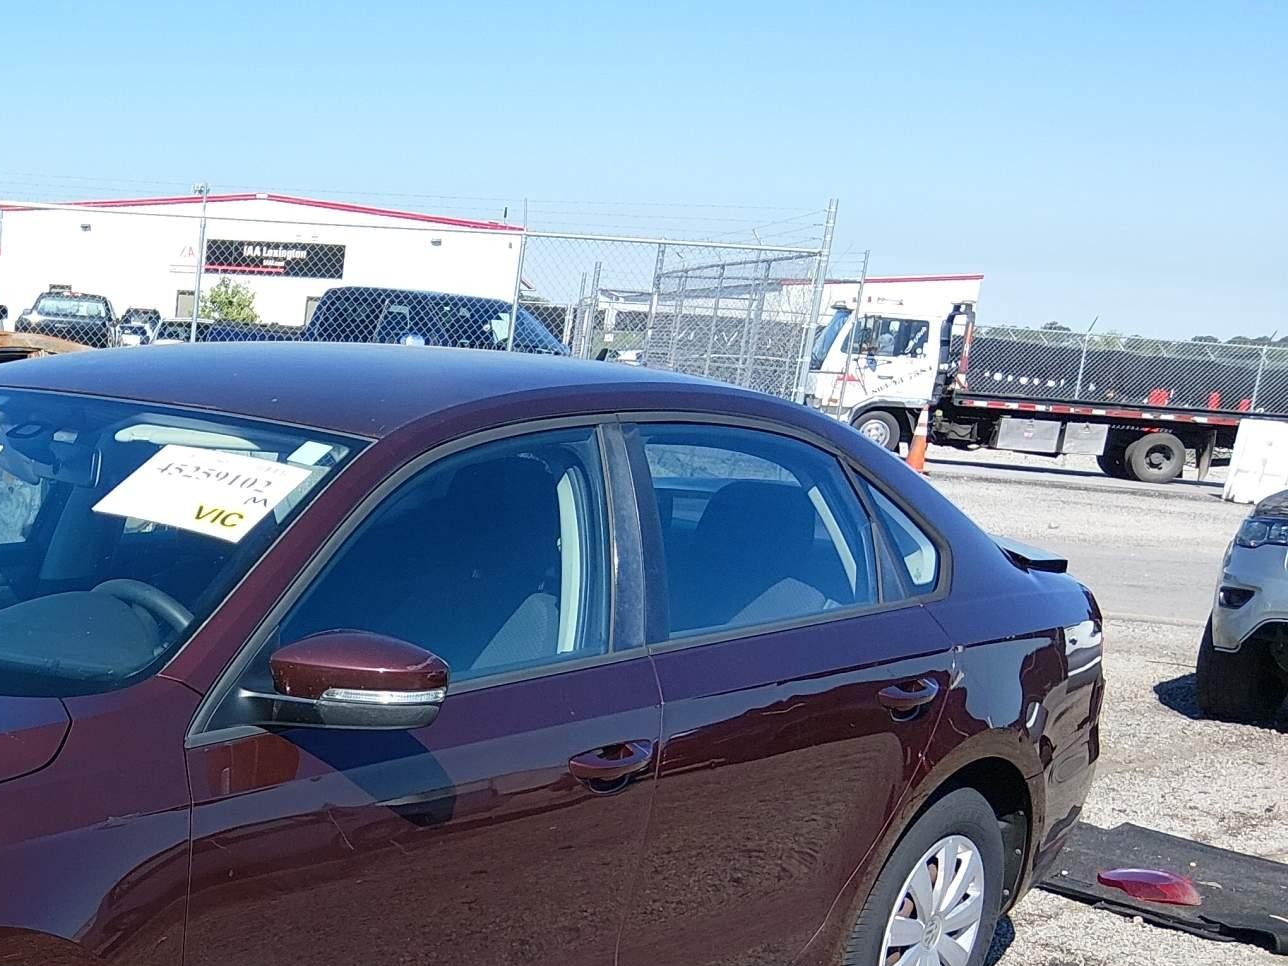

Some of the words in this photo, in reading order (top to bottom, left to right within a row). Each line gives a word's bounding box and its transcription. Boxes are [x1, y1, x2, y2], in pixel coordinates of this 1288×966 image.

[244, 245, 261, 256] IAA
[263, 246, 307, 260] Lexington
[157, 462, 272, 493] 45259102
[194, 505, 244, 528] VIC
